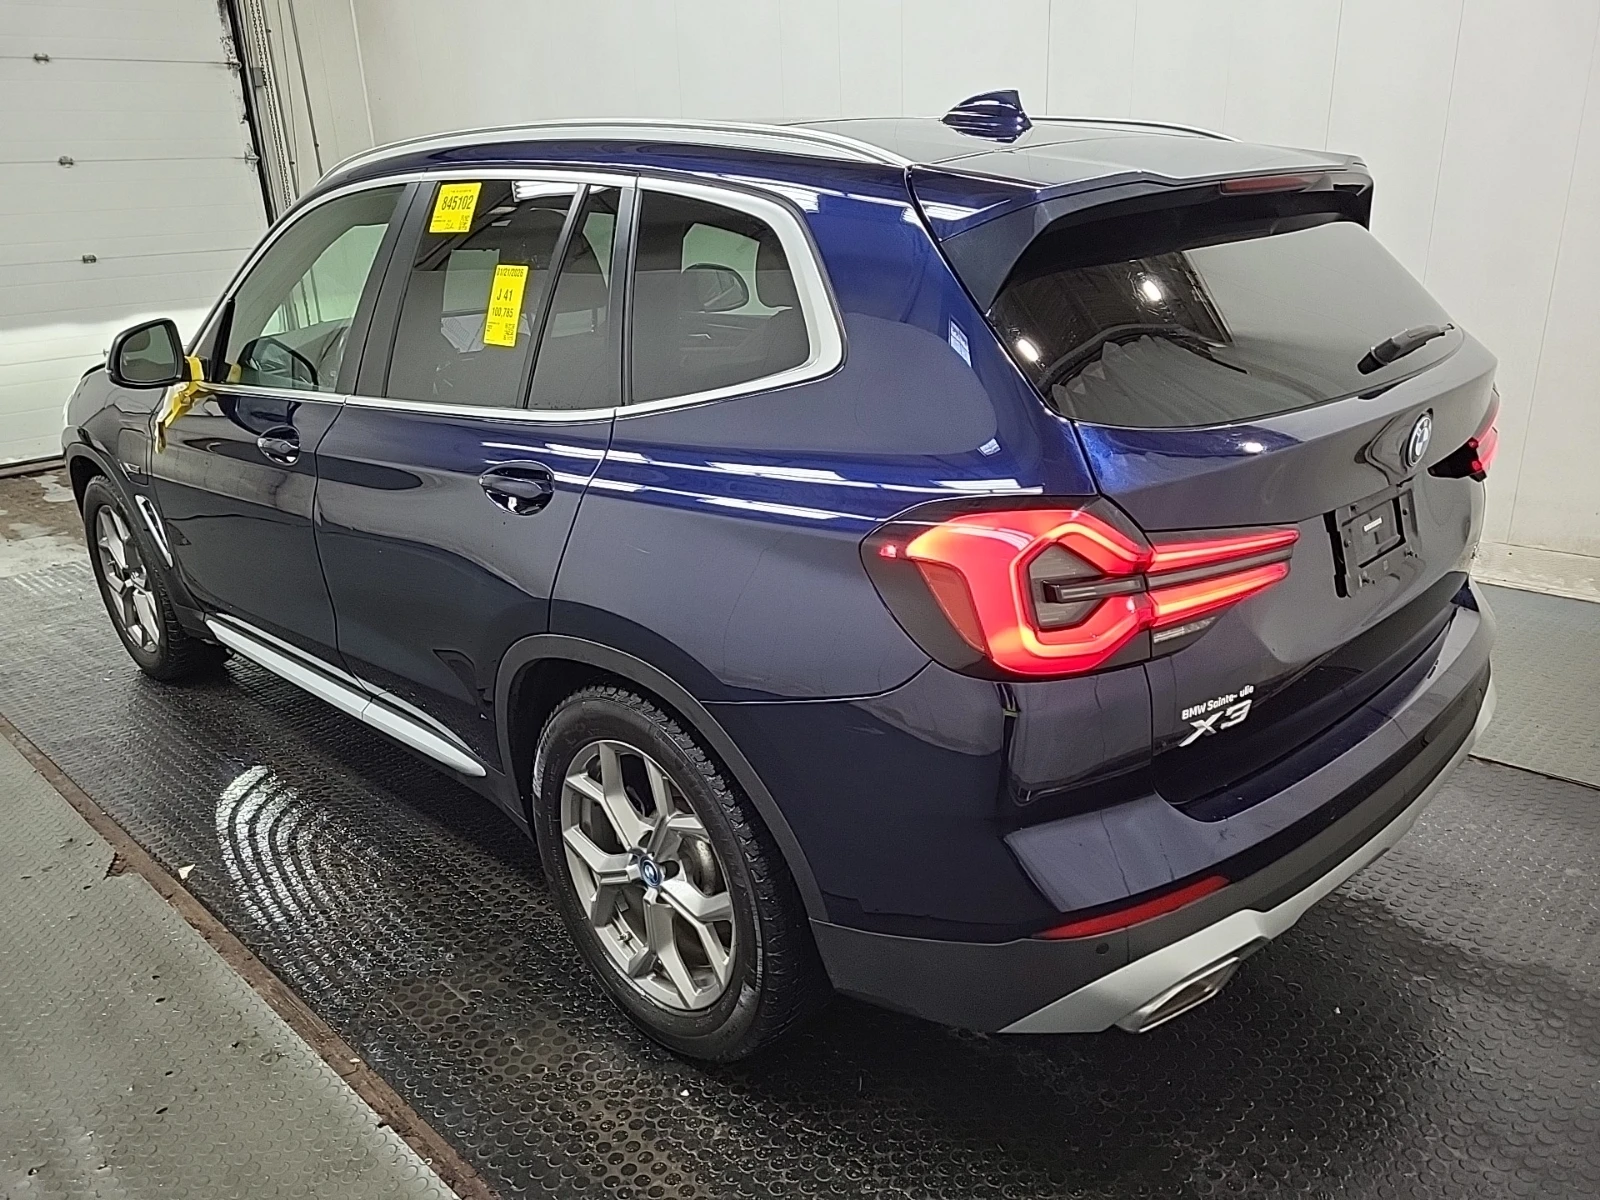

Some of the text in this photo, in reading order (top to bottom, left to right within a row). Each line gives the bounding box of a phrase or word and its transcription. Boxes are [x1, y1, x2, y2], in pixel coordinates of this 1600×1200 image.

[441, 195, 474, 210] 845102
[496, 288, 513, 302] J 41
[1181, 702, 1207, 720] BMW
[1178, 699, 1252, 747] X3
